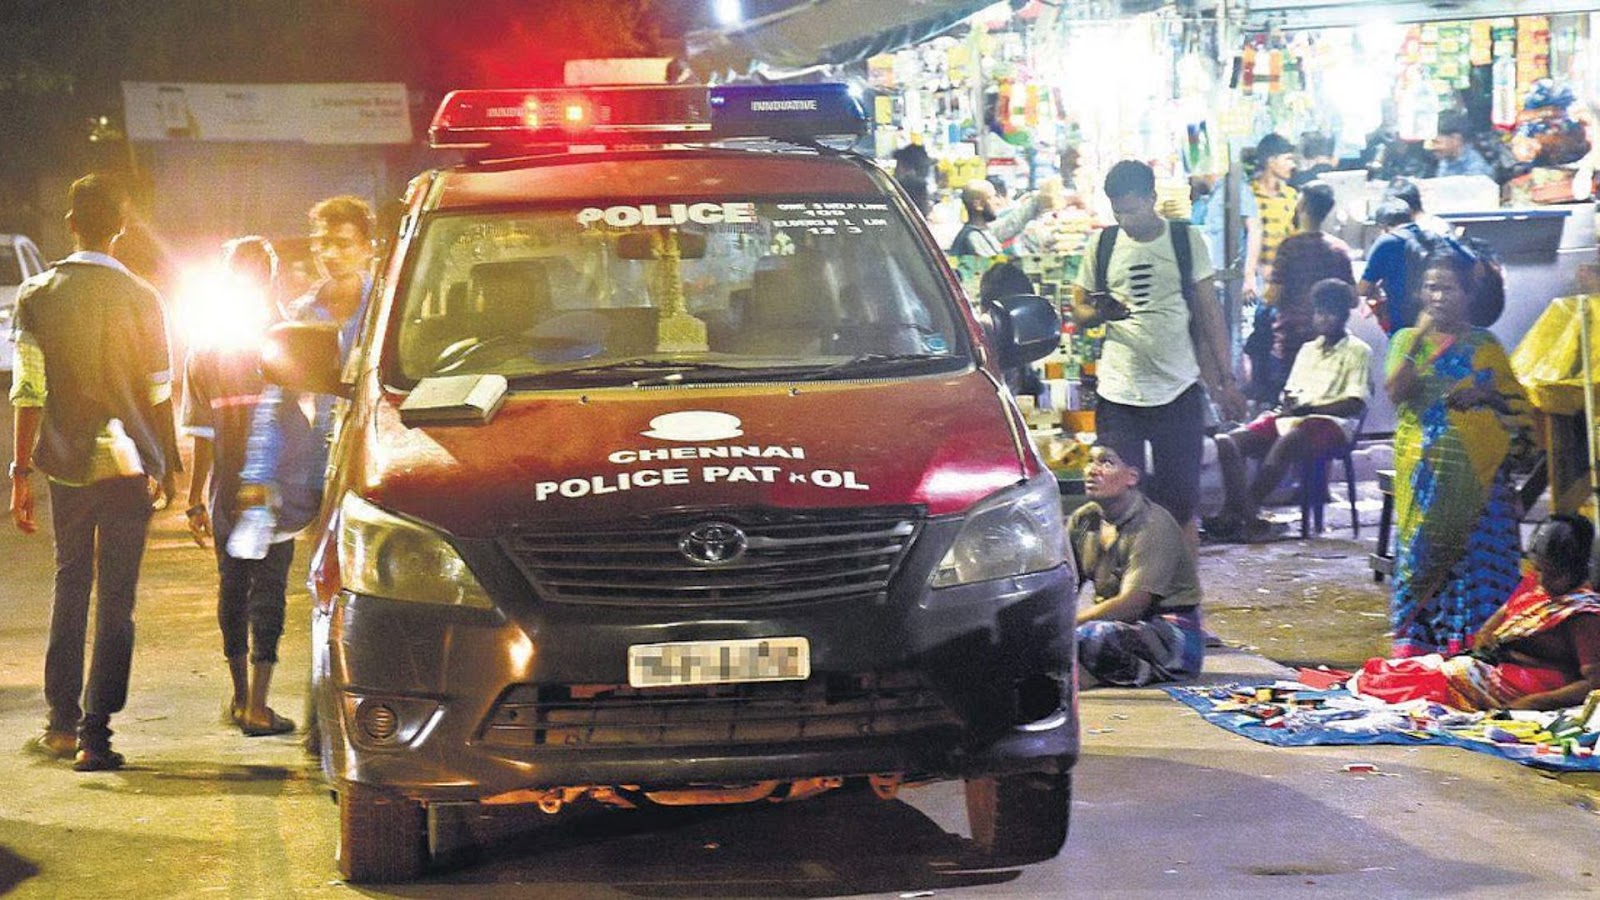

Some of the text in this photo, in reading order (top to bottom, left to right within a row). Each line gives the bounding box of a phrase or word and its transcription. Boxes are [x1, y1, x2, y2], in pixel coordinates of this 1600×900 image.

[750, 99, 818, 111] INNOVATIVE
[577, 202, 757, 228] POLICE
[608, 445, 805, 464] CHENNAI
[535, 467, 690, 501] POLICE
